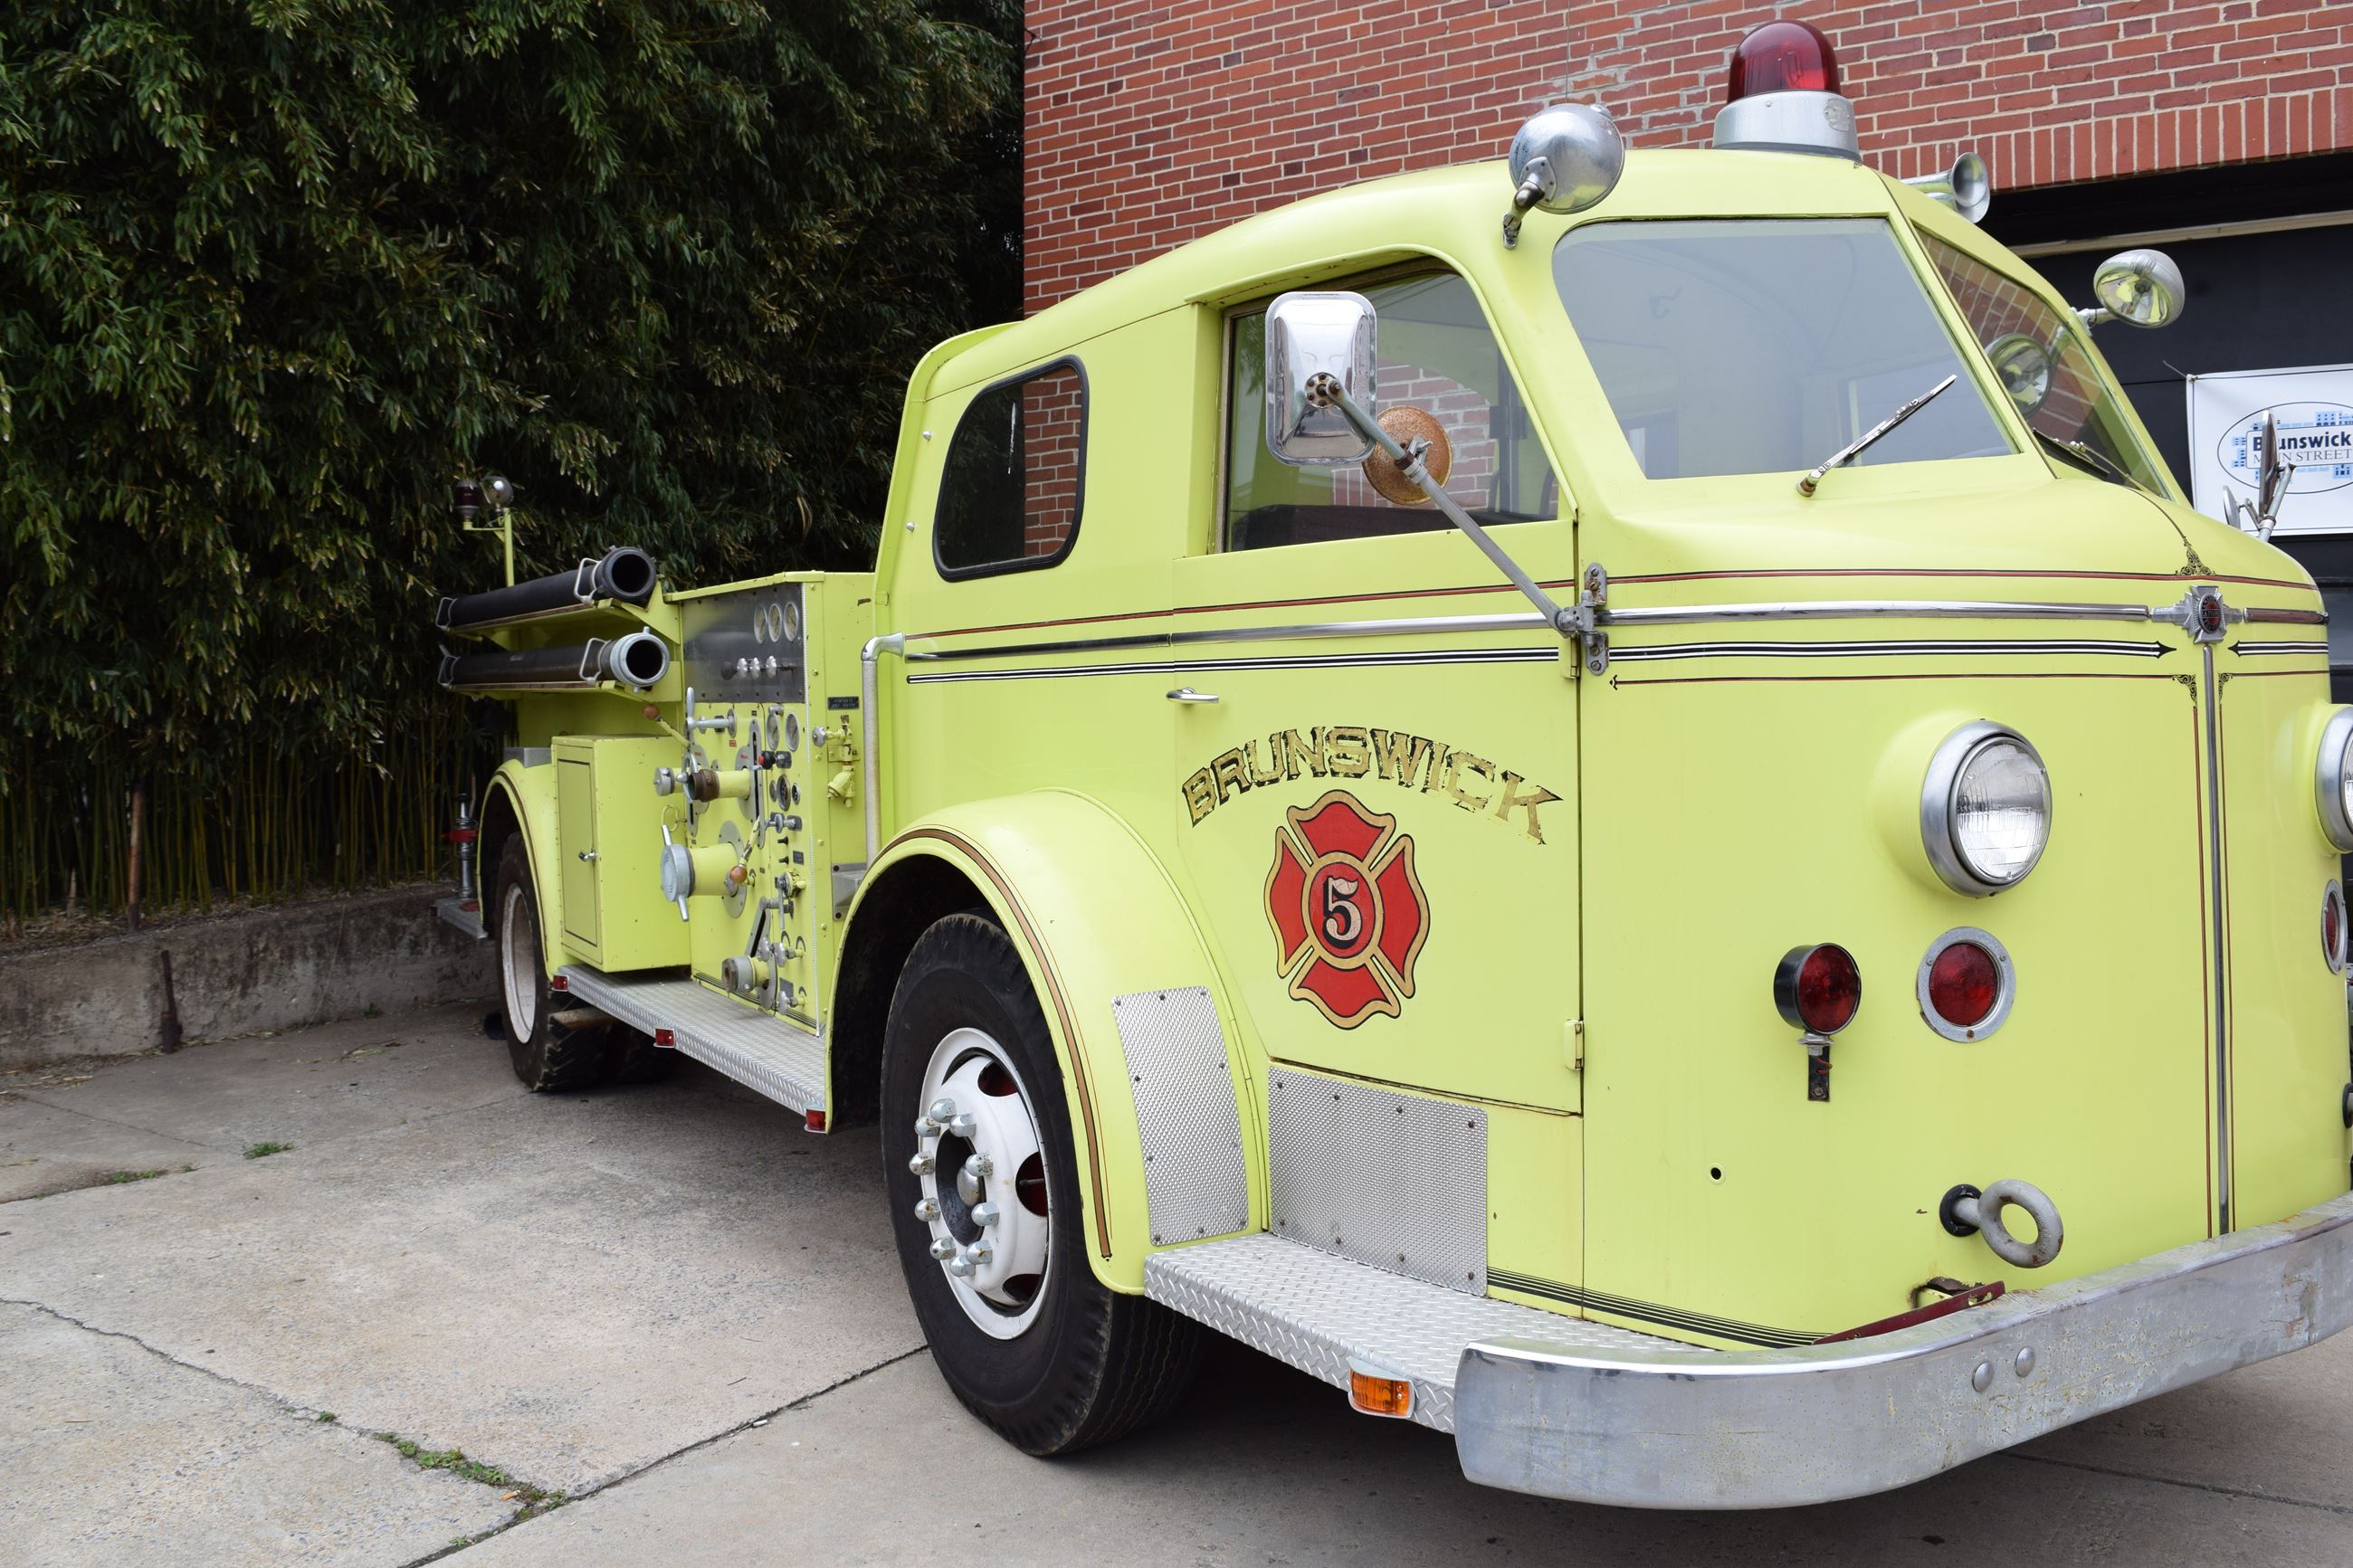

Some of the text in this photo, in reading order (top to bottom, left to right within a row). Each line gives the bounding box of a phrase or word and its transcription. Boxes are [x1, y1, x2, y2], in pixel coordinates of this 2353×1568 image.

[2253, 432, 2351, 451] Bunswick
[2296, 449, 2353, 461] STREET
[1182, 727, 1564, 845] BRUNSWICK
[1323, 875, 1363, 949] 5
